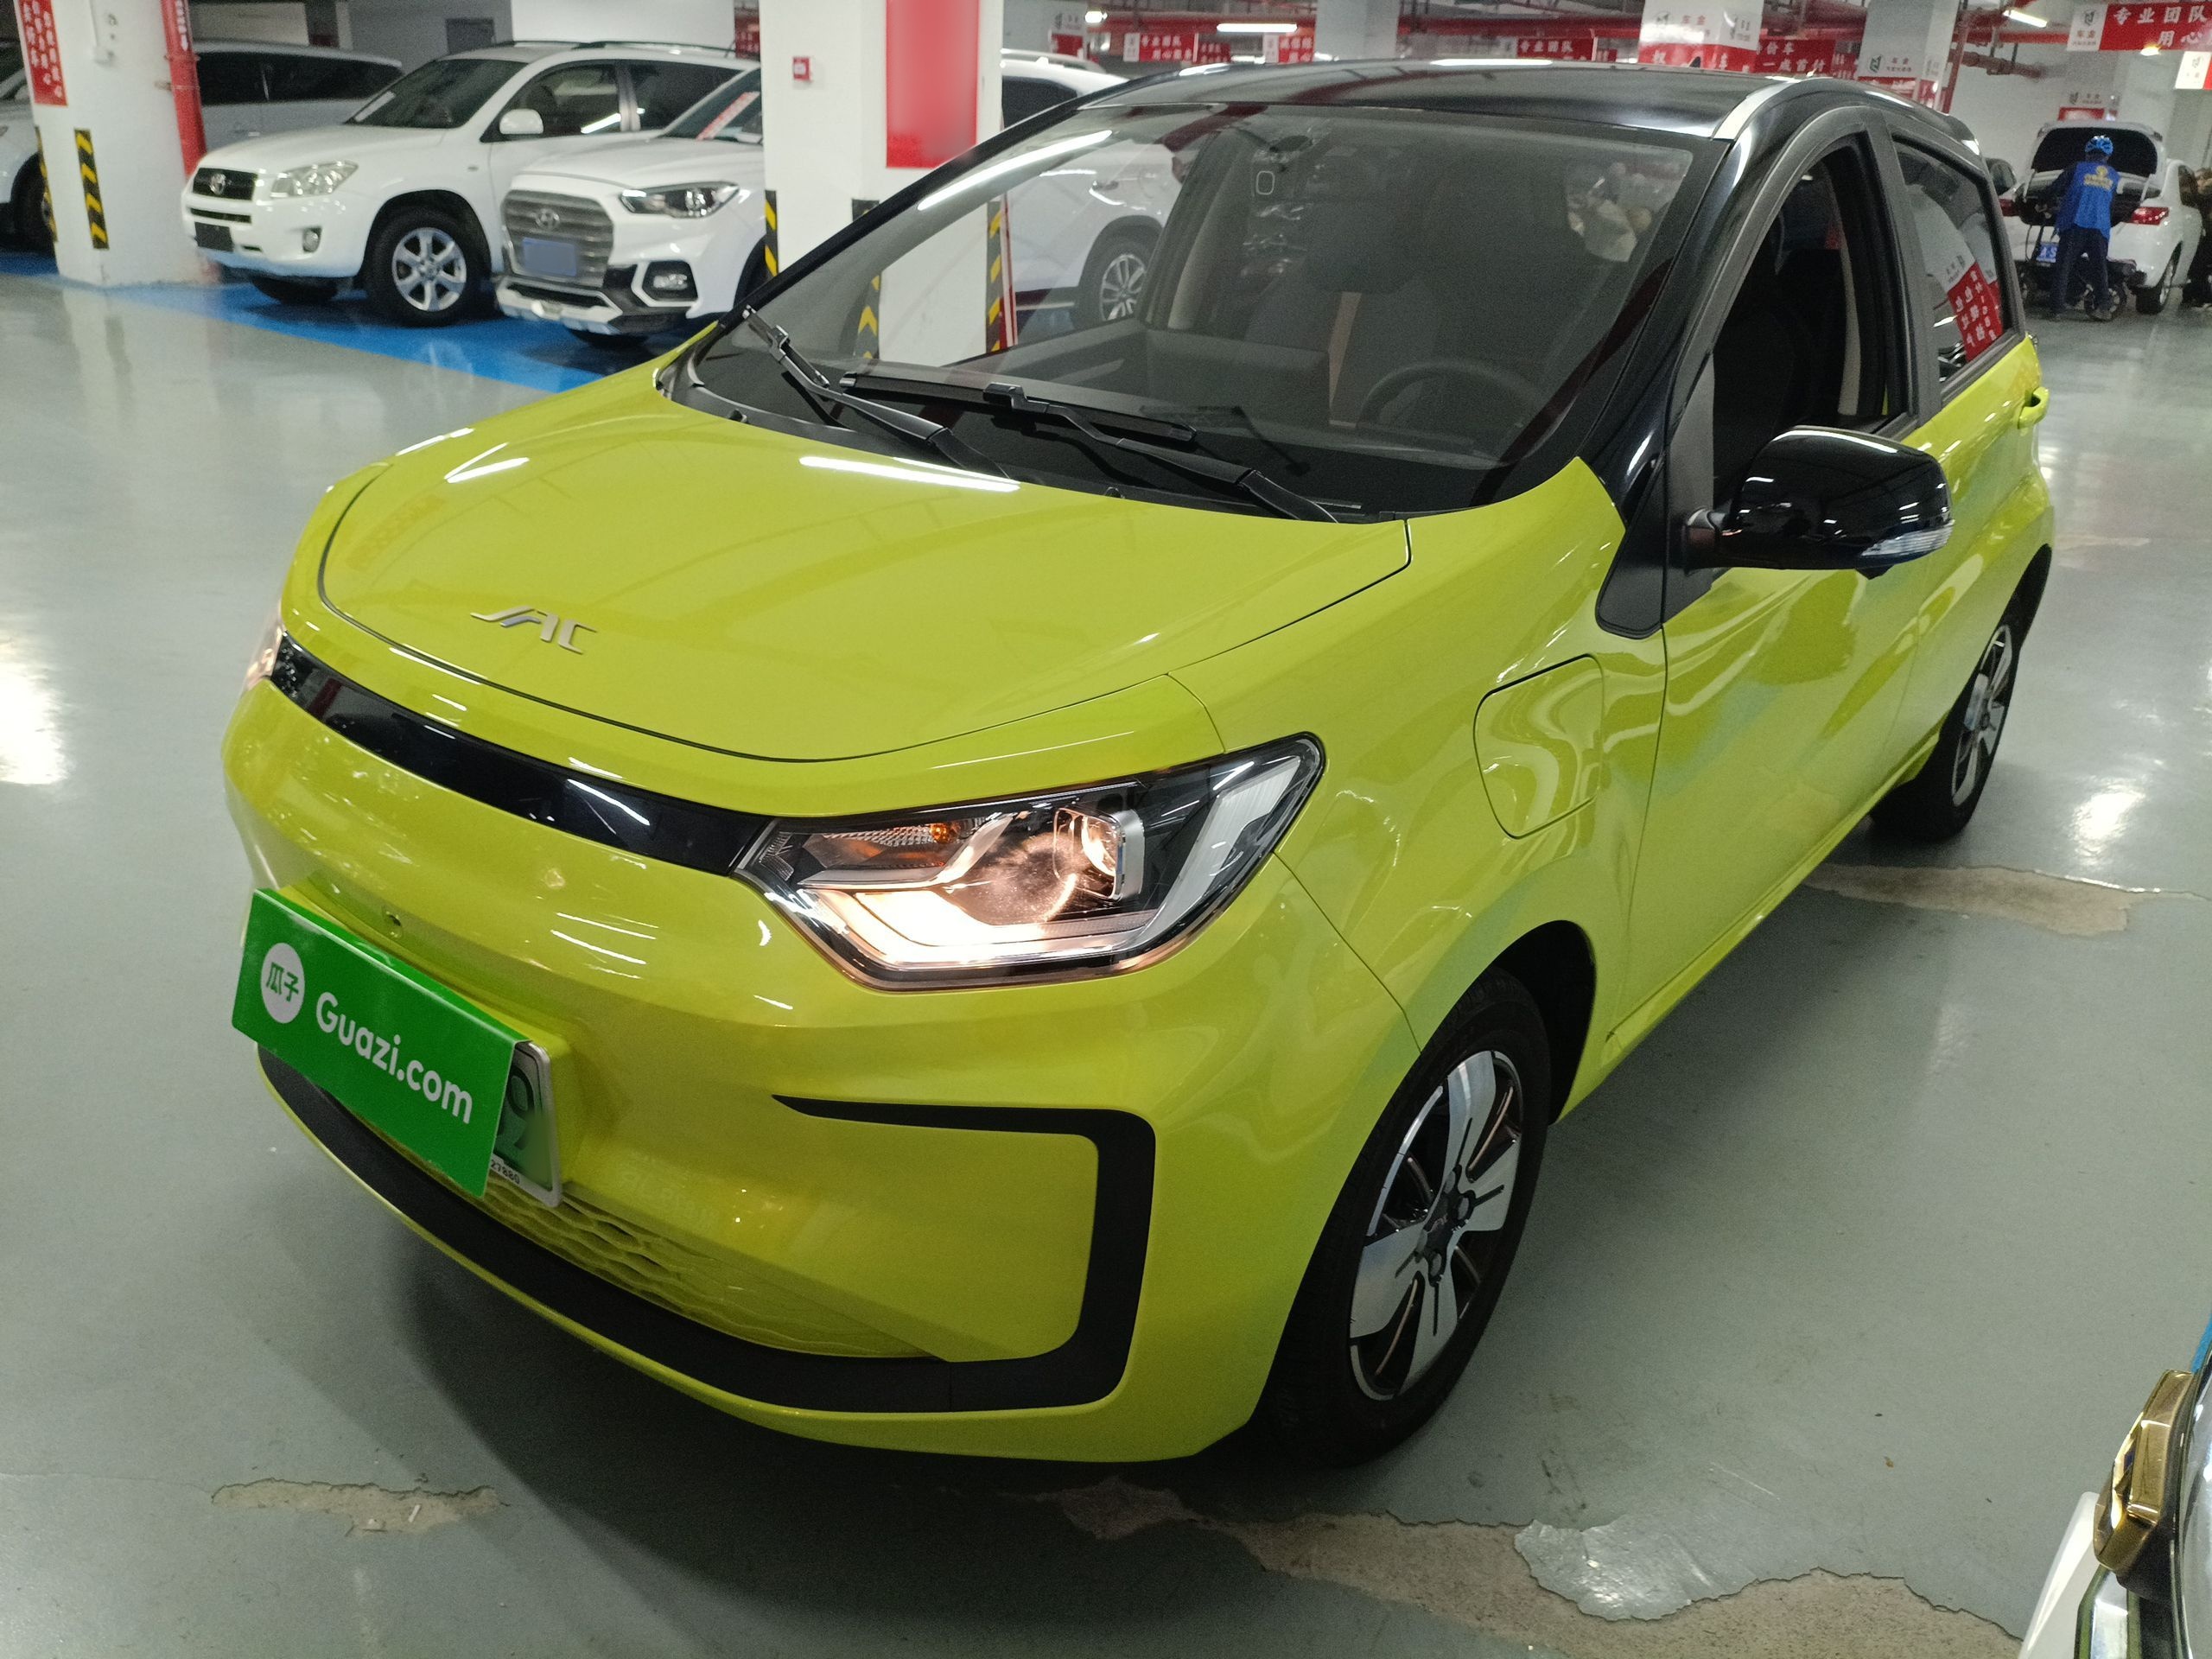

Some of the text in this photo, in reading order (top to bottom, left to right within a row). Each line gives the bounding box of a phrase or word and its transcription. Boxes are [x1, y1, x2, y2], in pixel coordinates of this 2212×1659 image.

[2113, 5, 2209, 25] 专业团队
[265, 961, 300, 1003] 瓜子
[316, 991, 473, 1124] Guazi.com
